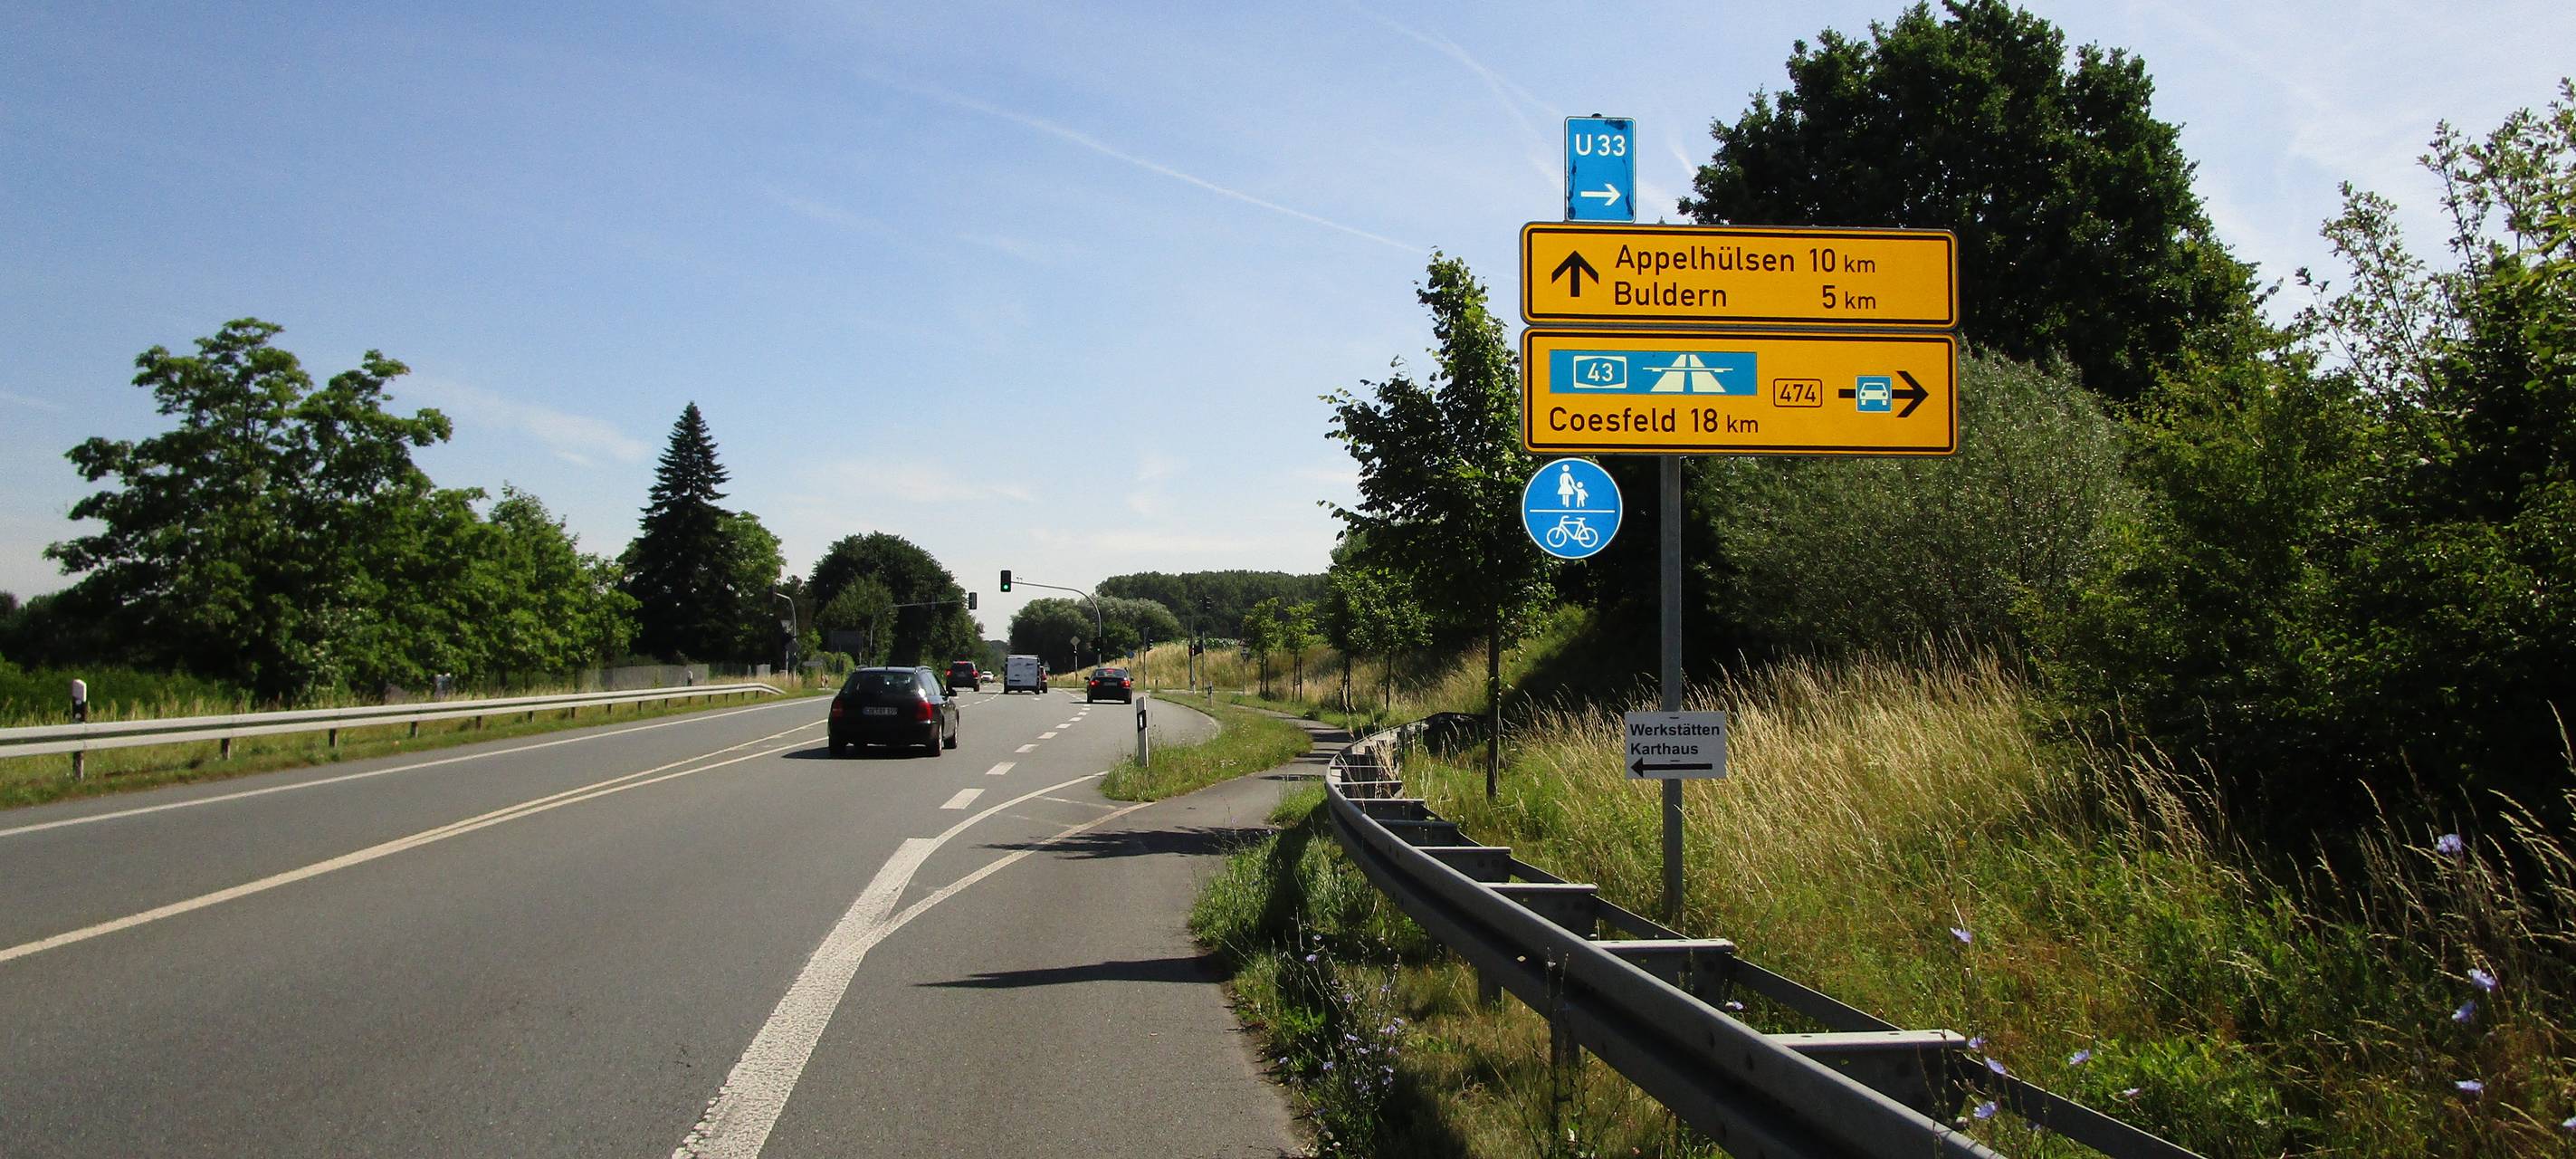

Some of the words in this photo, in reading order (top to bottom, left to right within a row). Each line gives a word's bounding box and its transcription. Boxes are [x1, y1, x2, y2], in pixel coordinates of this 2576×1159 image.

[1575, 133, 1592, 156] U
[1598, 134, 1626, 157] 33
[1615, 244, 1795, 274] Appelhülsen
[1809, 248, 1836, 273] 10
[1844, 254, 1875, 273] km
[1614, 281, 1727, 307] Buldern
[1822, 284, 1837, 310] 5
[1845, 291, 1876, 310] km
[1587, 363, 1614, 382] 43
[1779, 383, 1817, 403] 474
[1550, 406, 1675, 433] Coesfeld
[1691, 407, 1718, 433] 18
[1726, 414, 1759, 434] km
[1629, 723, 1720, 736] Werkstätten
[1630, 742, 1699, 755] Karthaus
